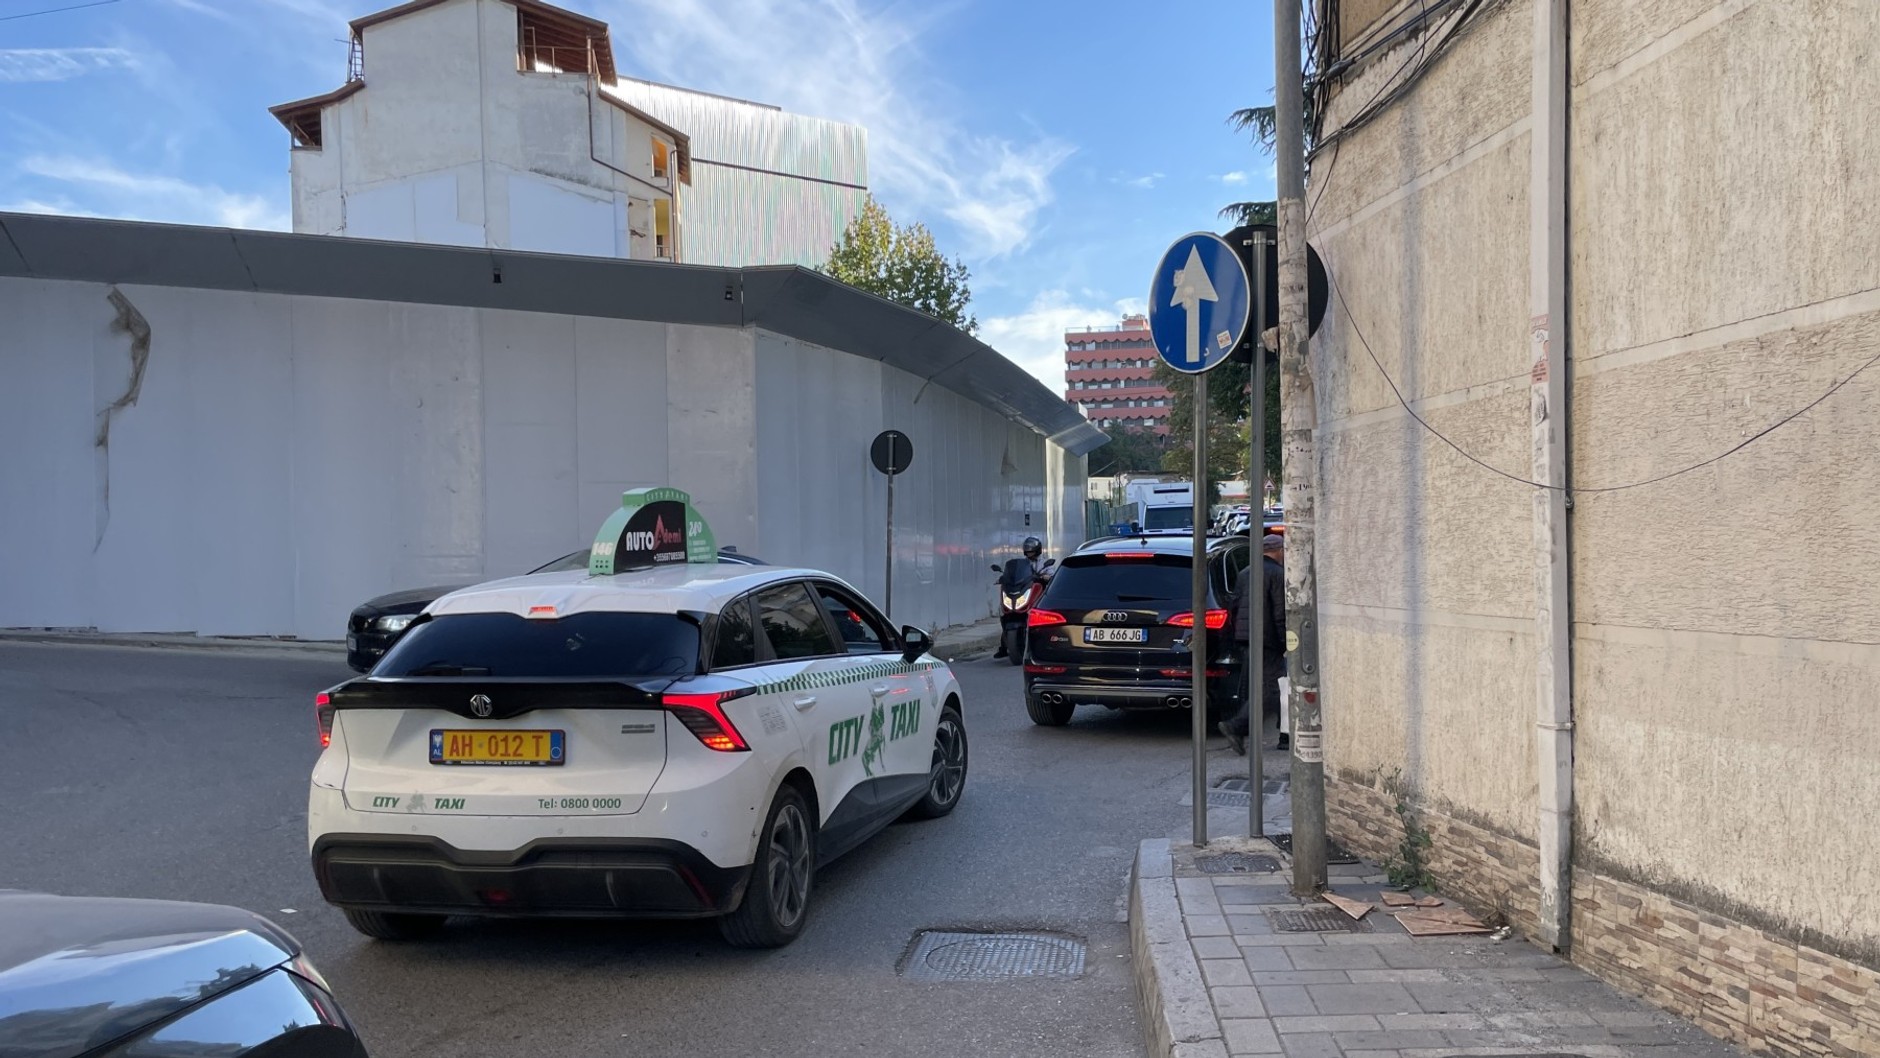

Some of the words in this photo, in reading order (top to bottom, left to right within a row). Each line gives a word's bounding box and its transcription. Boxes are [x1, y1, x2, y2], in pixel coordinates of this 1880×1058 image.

[626, 531, 655, 551] AUTO
[1093, 629, 1105, 640] AB
[1110, 629, 1127, 640] 666
[1129, 630, 1141, 641] JG
[828, 714, 865, 766] CITY
[889, 699, 921, 742] TAXI
[450, 735, 473, 757] AH
[487, 735, 524, 757] 012
[532, 735, 543, 757] T
[372, 796, 400, 808] CITY
[434, 798, 466, 810] TAXI
[538, 798, 558, 809] Tel:
[560, 798, 590, 809] 0800
[592, 798, 622, 809] 0000
